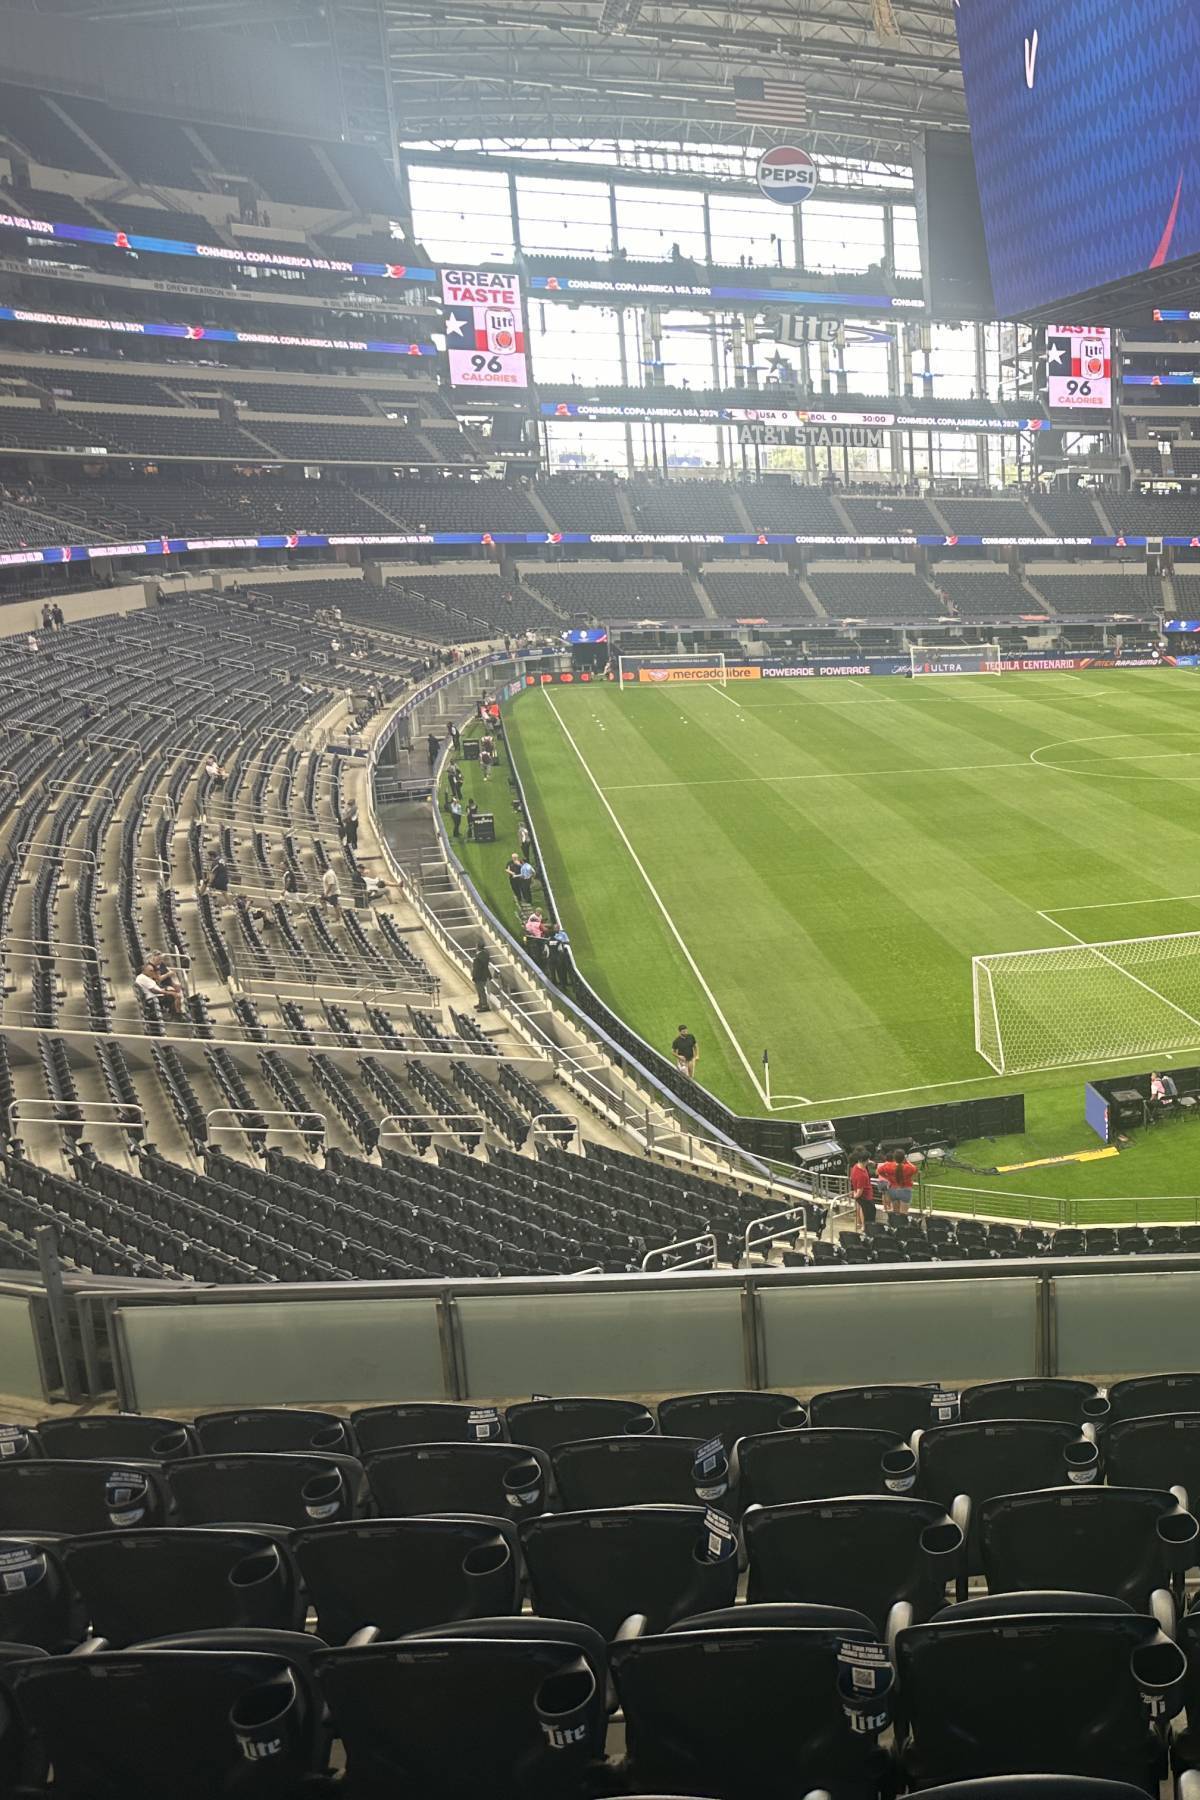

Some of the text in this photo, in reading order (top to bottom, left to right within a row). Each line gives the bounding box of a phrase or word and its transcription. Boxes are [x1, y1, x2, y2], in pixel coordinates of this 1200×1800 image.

[761, 168, 814, 184] PEPSI
[197, 245, 352, 272] CONMEBOL COPA AMERICA USA 2024
[446, 271, 516, 288] GREAT
[448, 287, 514, 304] TASTE
[471, 354, 502, 372] 96
[462, 372, 518, 382] CALORIES
[1067, 380, 1092, 396] 96
[1058, 396, 1103, 404] CALORIES
[739, 426, 884, 448] AT&T STADIUM
[673, 666, 751, 679] mercado libre
[762, 666, 870, 677] POWERADE POWERADE
[930, 664, 962, 672] ULTRA
[985, 659, 1074, 671] TEQUILA CENTENARIO
